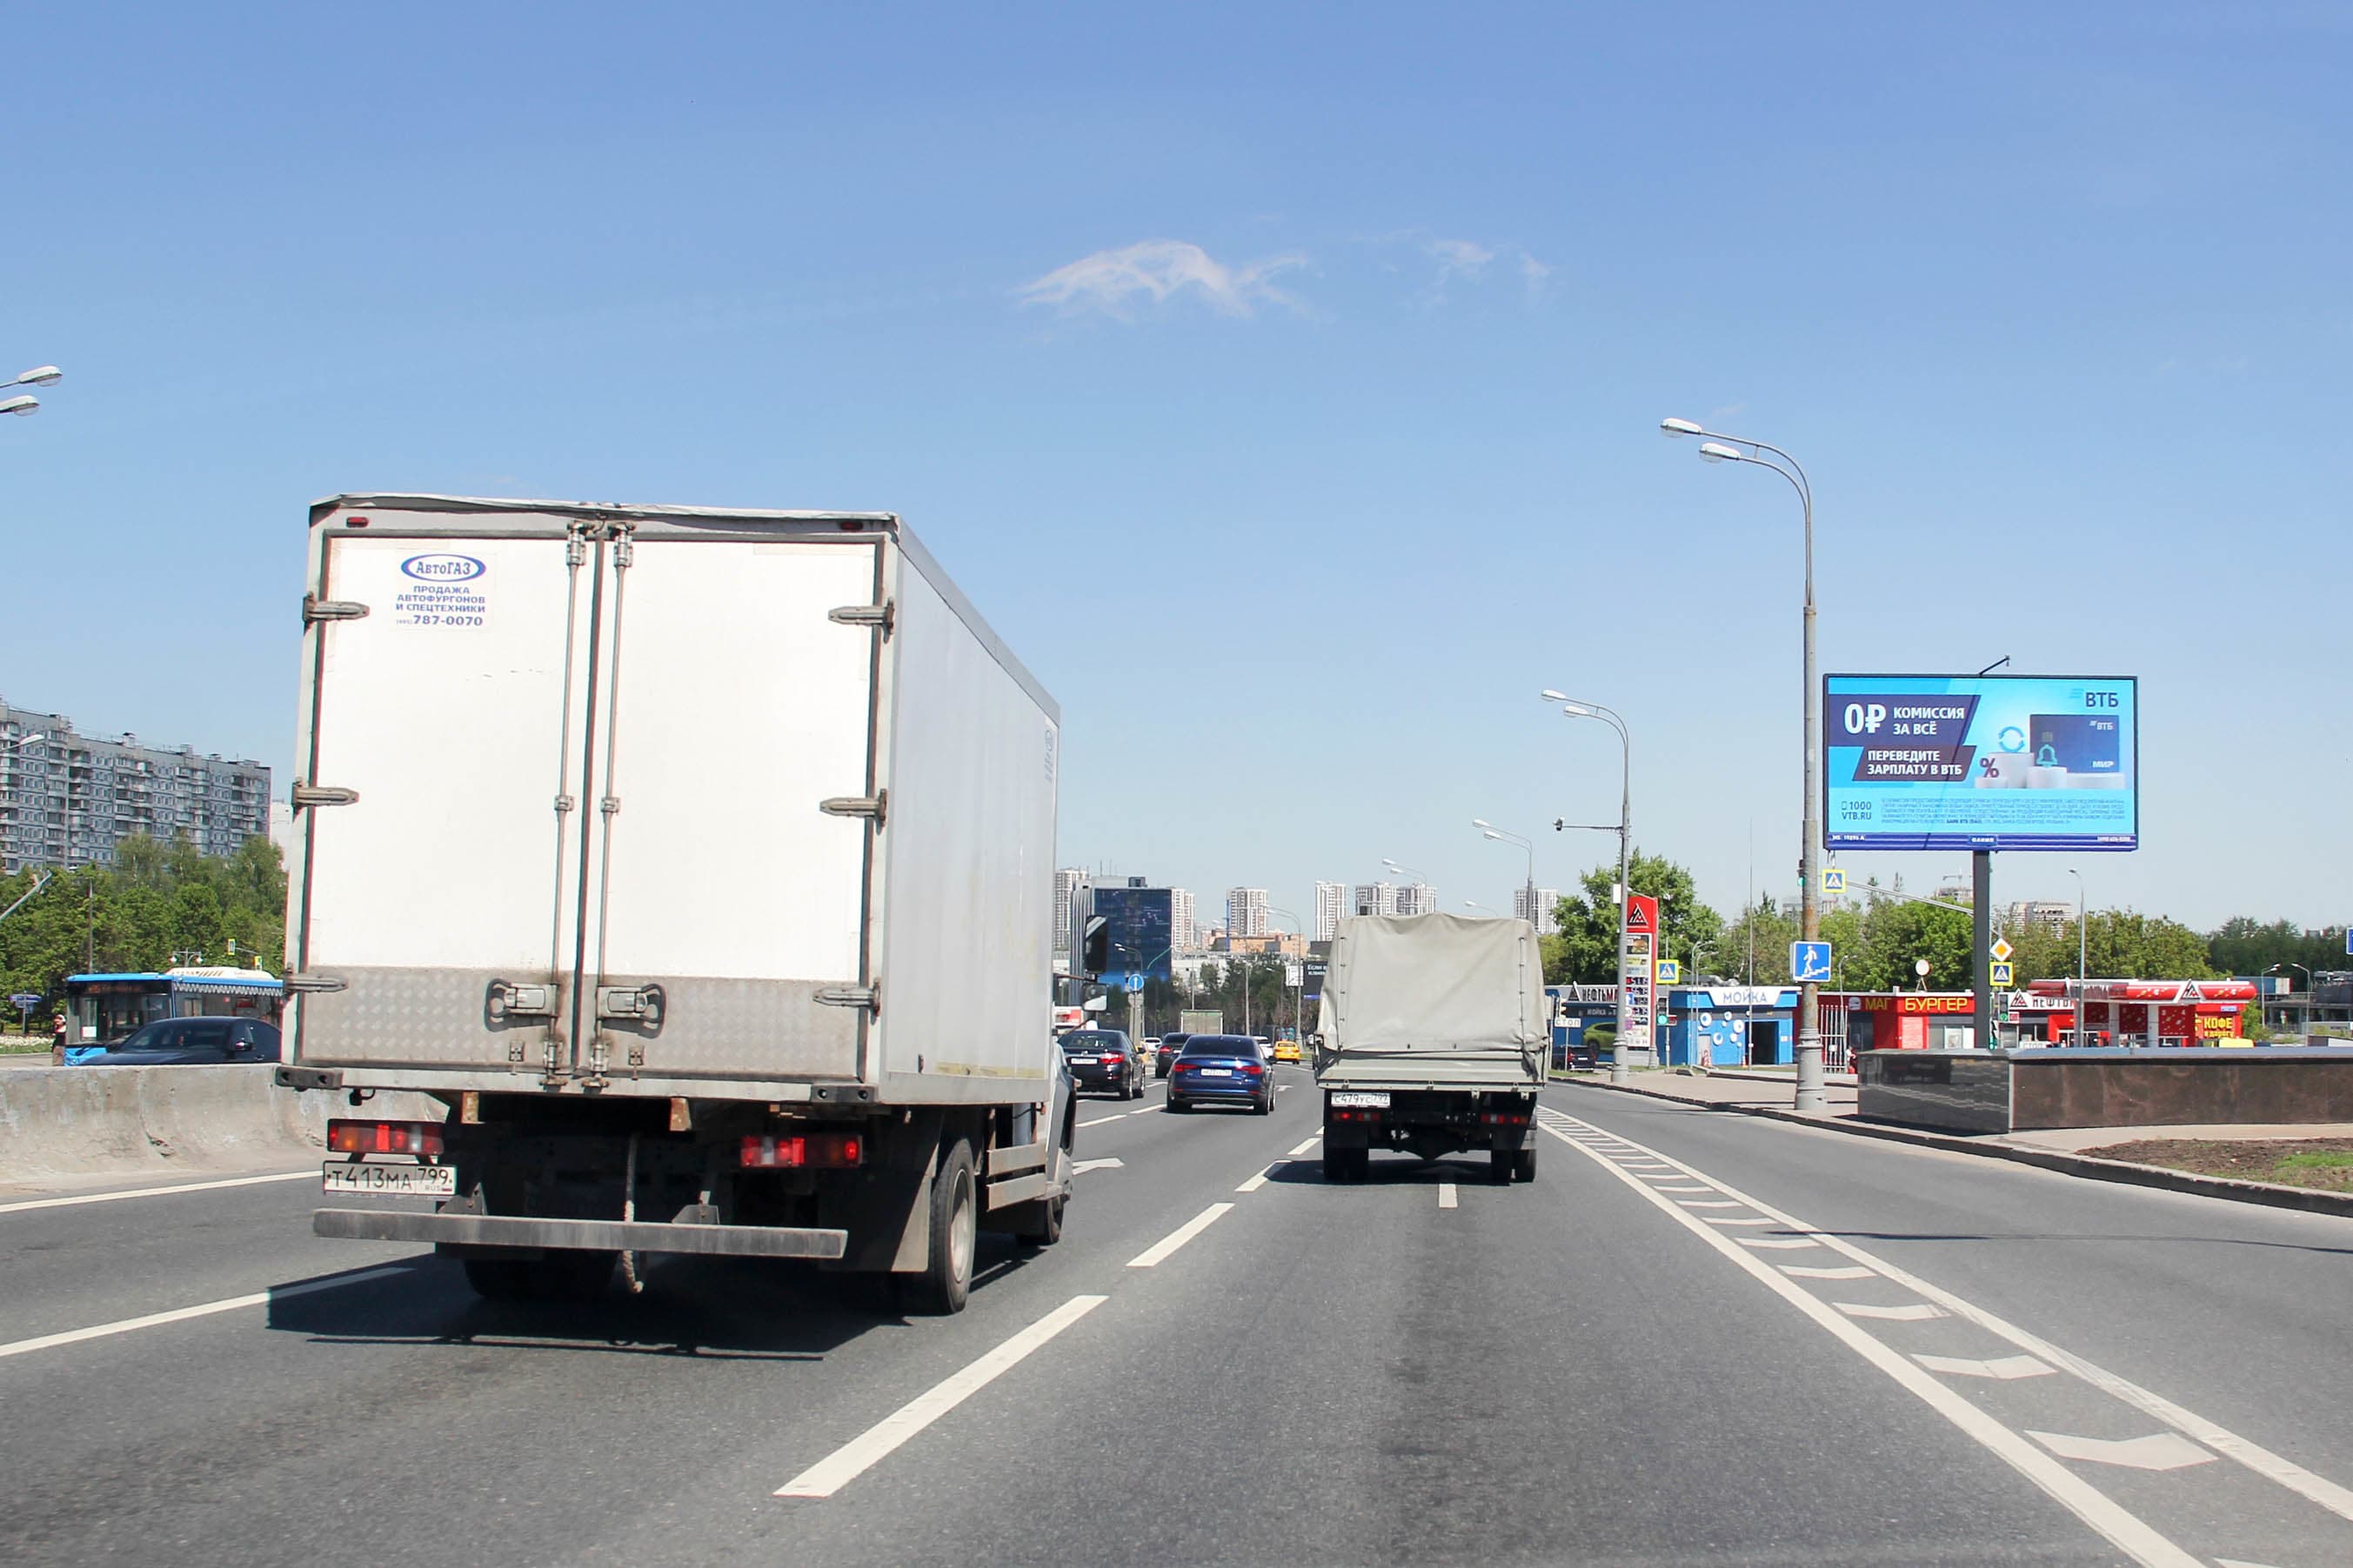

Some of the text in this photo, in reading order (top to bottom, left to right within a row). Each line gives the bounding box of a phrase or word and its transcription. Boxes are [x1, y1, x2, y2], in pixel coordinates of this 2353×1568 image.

[413, 585, 470, 595] ПРОДАЖА
[397, 594, 485, 604] АВТОФУРГОНОВ
[406, 604, 485, 613] СПЕЦТЕХНИКИ
[413, 615, 483, 626] 787-0070
[2085, 692, 2119, 708] ВТБ
[1893, 707, 1965, 719] КОМИССИЯ
[1893, 721, 1937, 735] ЗА ВСЁ
[1868, 750, 1941, 763] ПЕРЕВЕДИТЕ
[1868, 764, 1962, 776] ЗАРПЛАТУ В ВТБ
[1849, 801, 1871, 811] 1000
[1842, 811, 1872, 820] VTB.RU
[1723, 988, 1768, 1003] МОЙКА
[1865, 998, 1969, 1011] МАГ БУРГЕР
[2203, 1017, 2234, 1030] КОФЕ
[332, 1166, 449, 1191] Т413МА 799
